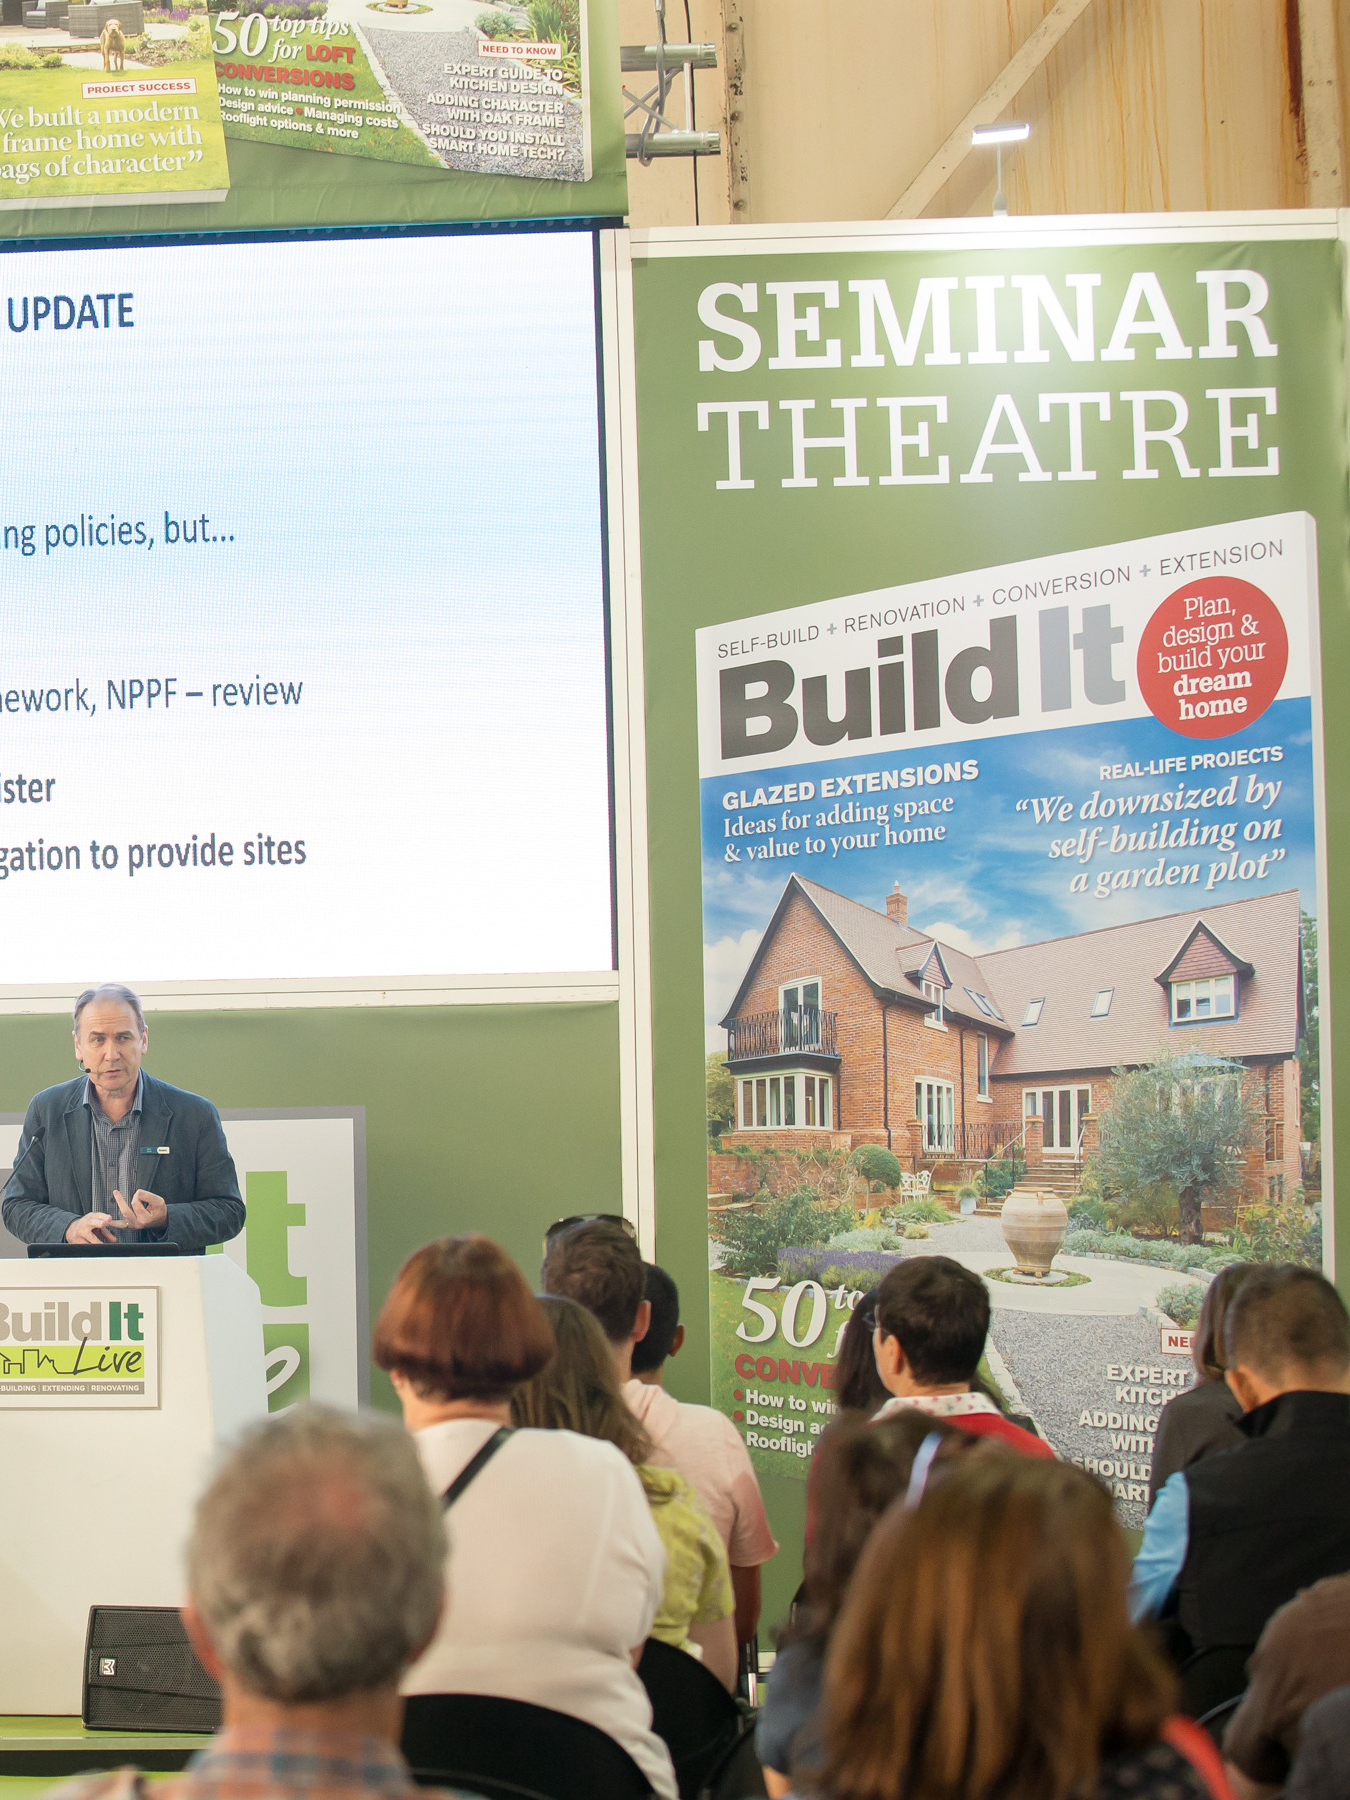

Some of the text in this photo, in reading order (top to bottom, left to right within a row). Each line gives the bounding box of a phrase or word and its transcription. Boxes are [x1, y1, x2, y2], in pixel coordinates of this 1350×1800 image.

[212, 11, 268, 56] 50
[483, 45, 556, 55] NEED TO KNOW
[306, 44, 355, 63] LOFT
[87, 82, 191, 94] PROJECT SUCCESS
[450, 77, 563, 95] KITCHEN DESIGN
[28, 106, 83, 127] built
[88, 110, 100, 125] a
[106, 101, 200, 124] modern
[2, 130, 72, 153] frame
[77, 129, 145, 150] home
[149, 124, 202, 146] with
[45, 155, 69, 176] of
[73, 150, 203, 174] character”
[8, 293, 134, 332] UPDATE
[698, 268, 1278, 372] SEMINAR
[698, 387, 1280, 490] THEATRE
[45, 513, 154, 555] policies,
[718, 539, 1284, 659] SELF-BUILD RENOVATION CONVERSION EXTENSION
[1184, 596, 1236, 620] Plan,
[1163, 614, 1260, 647] design &
[1158, 640, 1266, 673] build your
[107, 678, 177, 710] NPPF
[212, 674, 303, 706] review
[719, 604, 1126, 760] Build It
[1173, 670, 1252, 696] dream
[1179, 696, 1247, 720] home
[1100, 746, 1284, 780] REAL-LIFE PROJECTS
[723, 760, 979, 810] GLAZED EXTENSIONS
[1016, 774, 1283, 825] “We downsized by
[724, 797, 954, 837] Ideas for adding space
[90, 840, 118, 869] to
[129, 833, 234, 876] provide
[243, 832, 306, 866] sites
[724, 824, 946, 862] & value to your home
[1048, 818, 1282, 863] self-building on
[1070, 848, 1286, 899] a garden plot”
[109, 1302, 144, 1341] It
[736, 1276, 827, 1348] 50
[73, 1337, 142, 1375] Live
[1107, 1364, 1188, 1386] EXPERT
[746, 1389, 807, 1411] How to
[746, 1410, 805, 1434] Design
